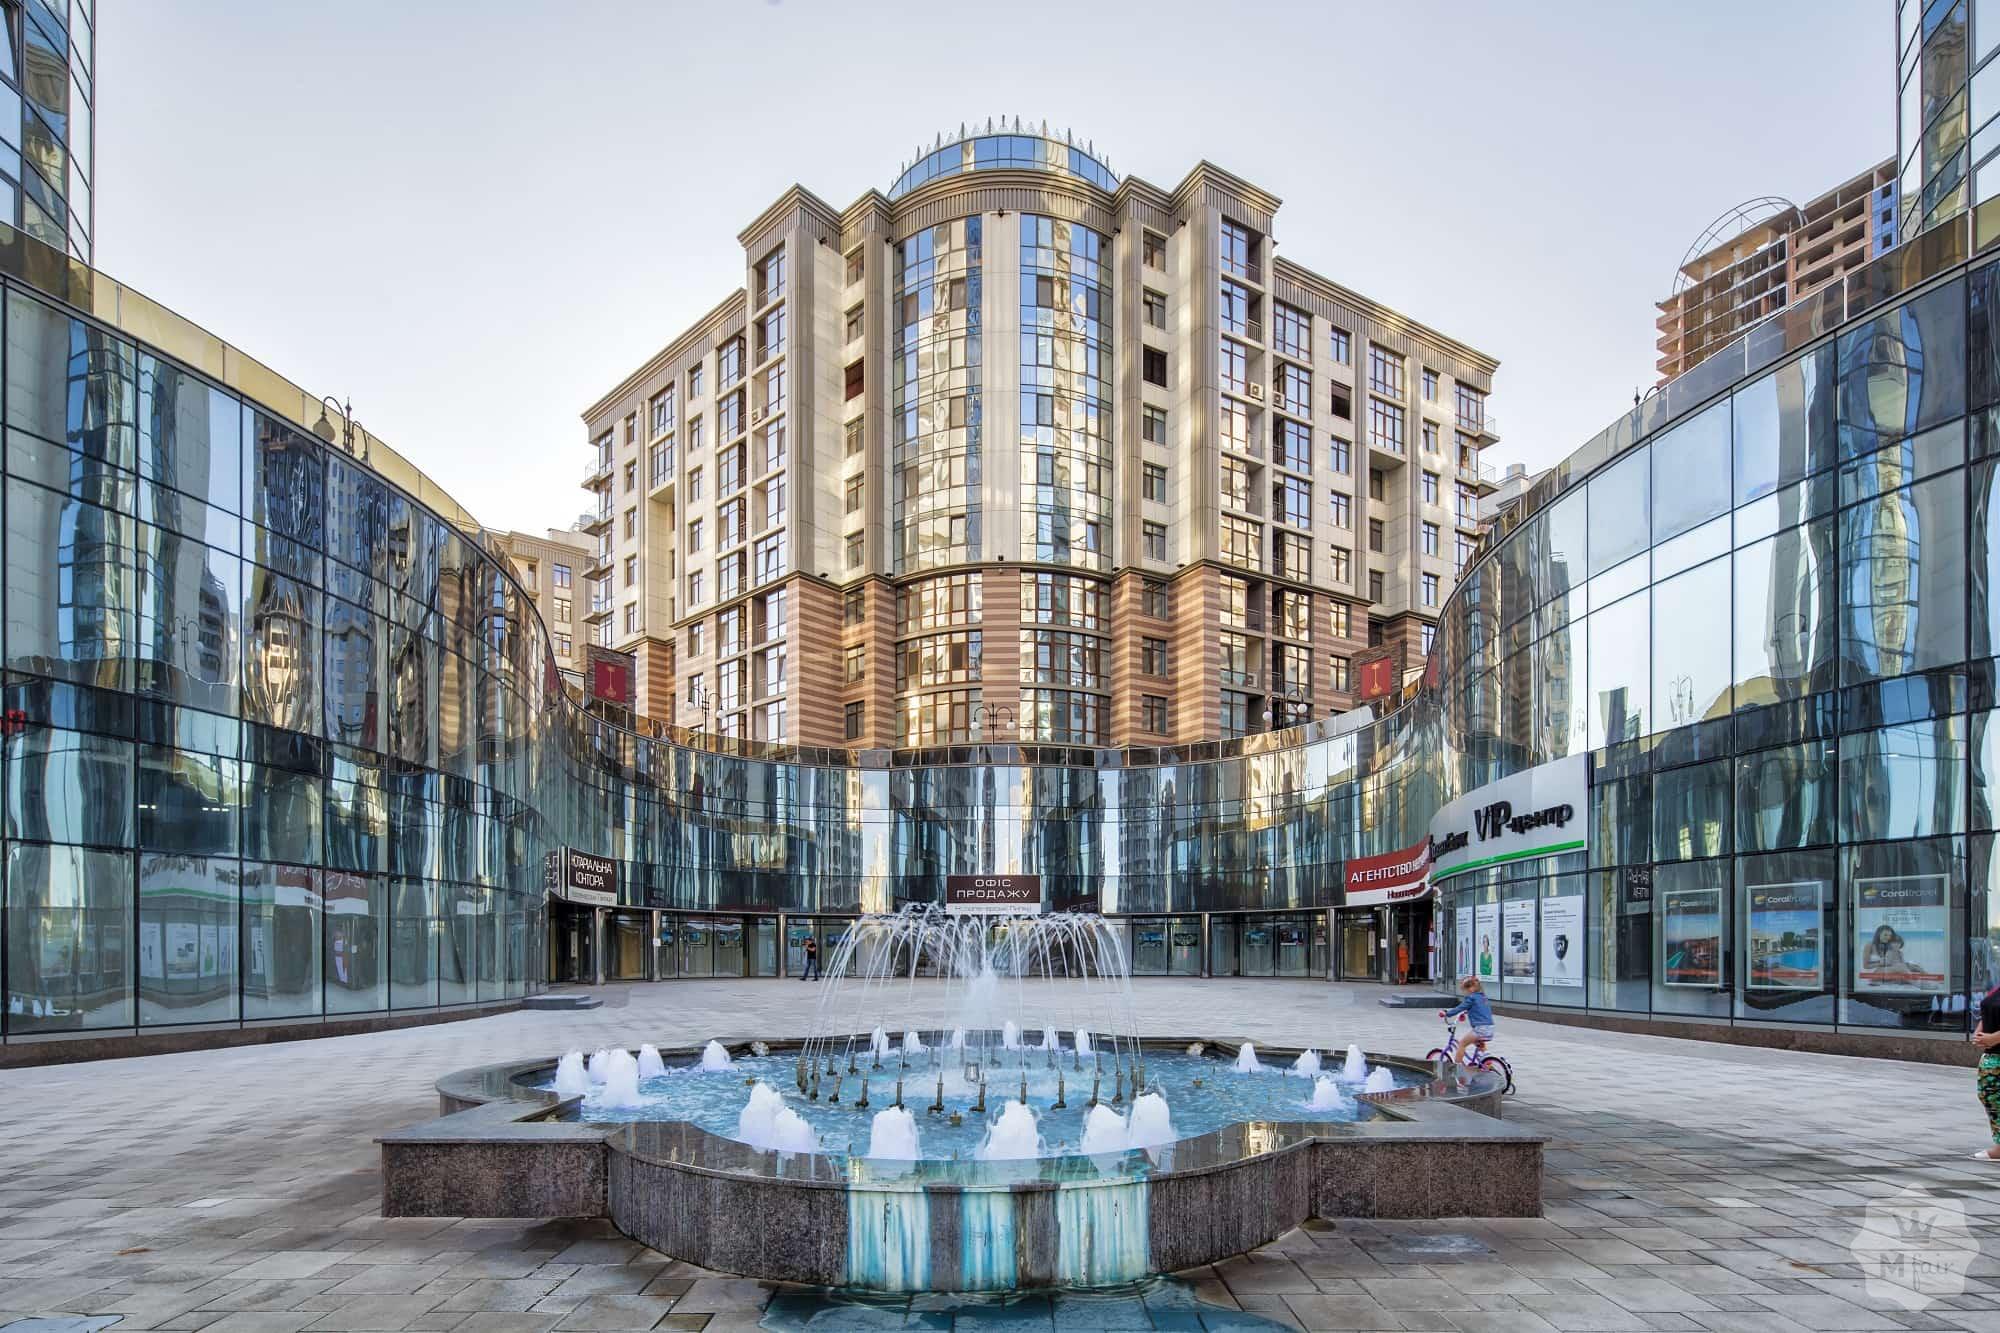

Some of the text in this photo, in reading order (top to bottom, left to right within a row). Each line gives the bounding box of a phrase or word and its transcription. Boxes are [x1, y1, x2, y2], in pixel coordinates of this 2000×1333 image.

[1474, 800, 1574, 842] VIP-центр
[1350, 861, 1412, 883] АГЕНТСТВО
[975, 879, 1012, 887] ОФІС
[956, 888, 1030, 899] ПРОДАЖУ
